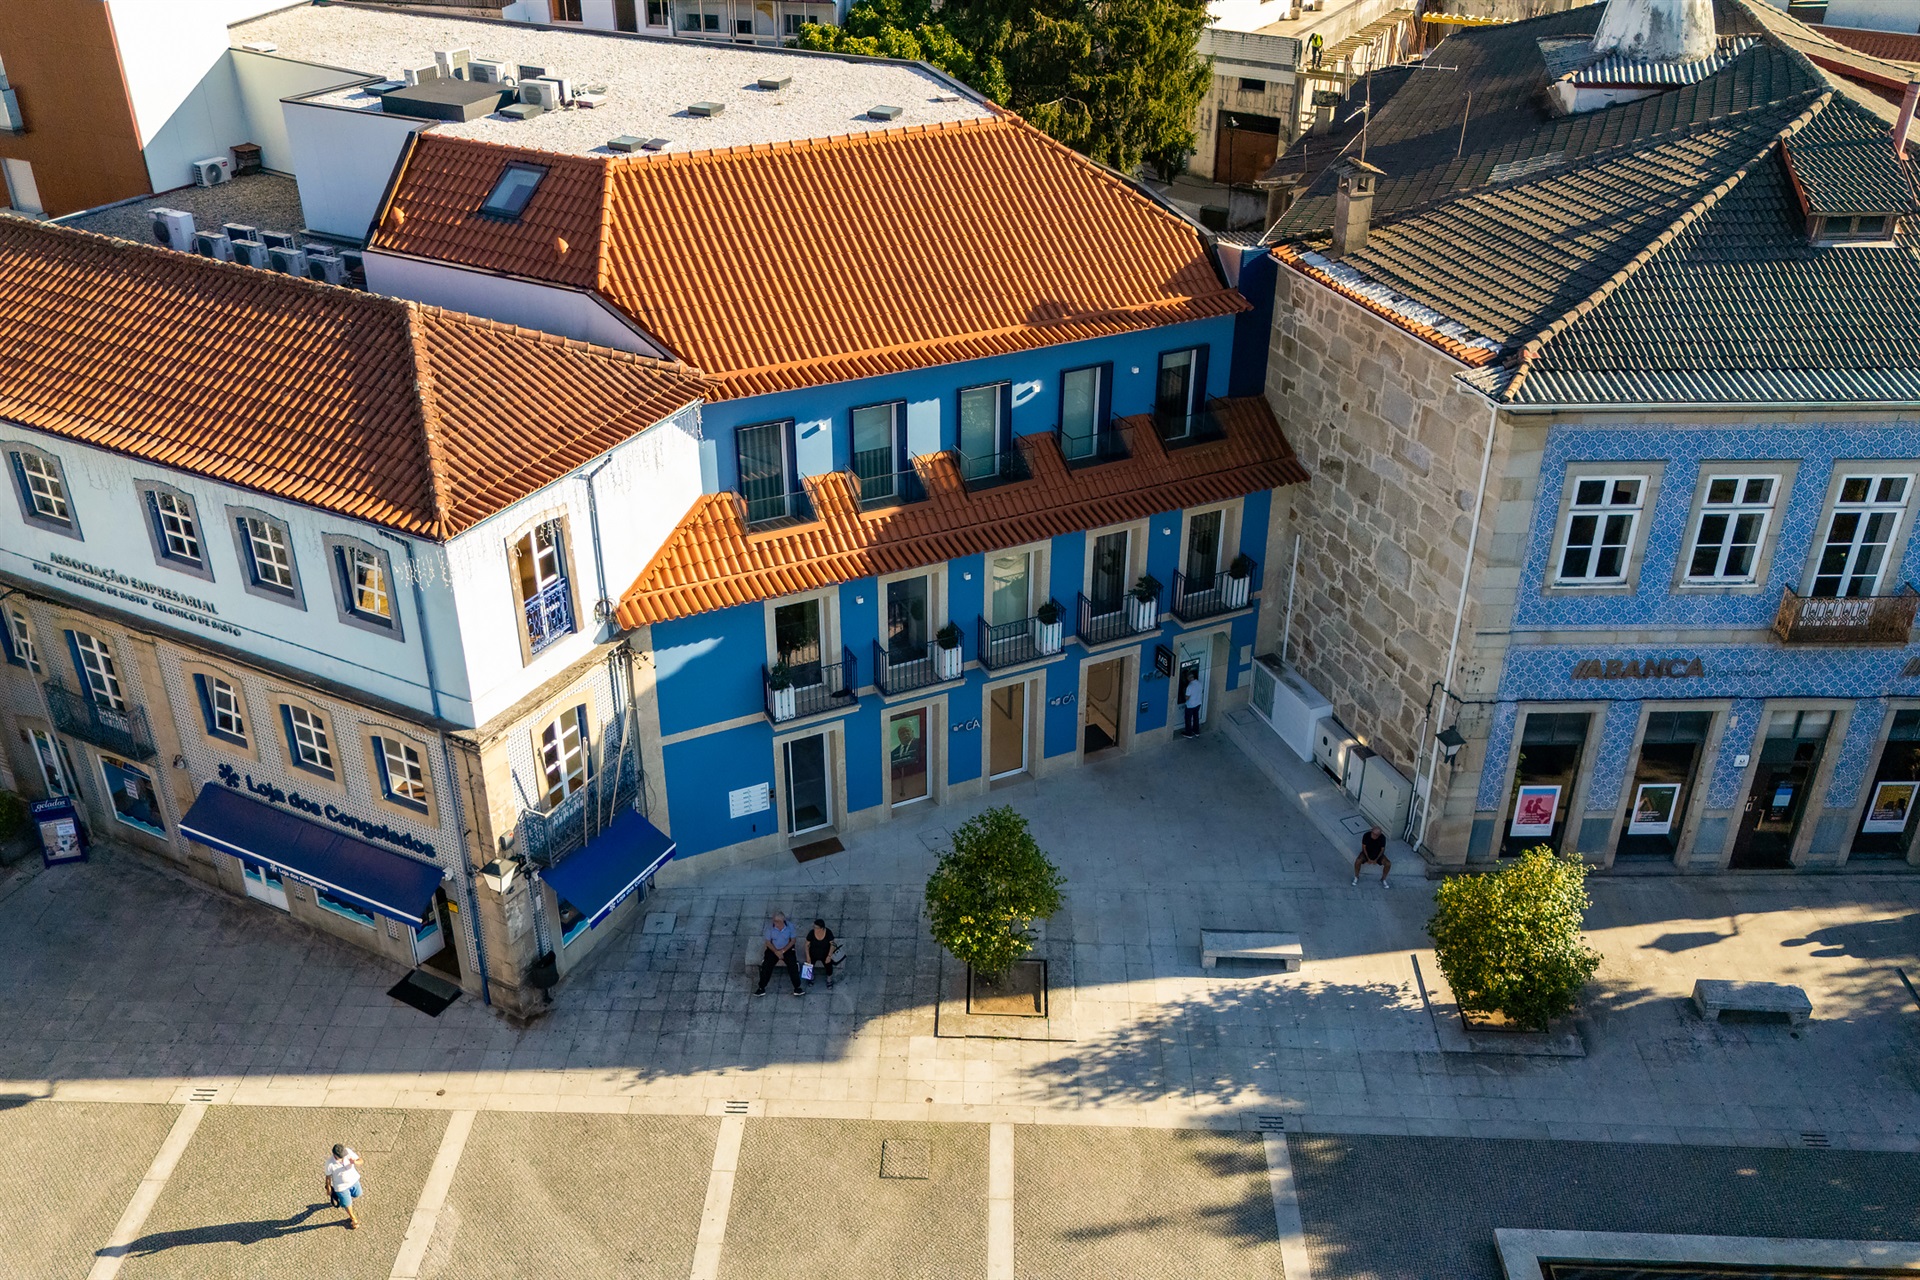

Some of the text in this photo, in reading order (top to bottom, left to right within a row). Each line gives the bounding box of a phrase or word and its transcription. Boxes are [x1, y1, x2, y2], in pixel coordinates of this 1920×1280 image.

[50, 552, 219, 615] ASSOCIAÇÃO EMPRESARIAL
[56, 570, 106, 592] CABECEIRAS
[106, 586, 119, 597] DE
[119, 590, 148, 606] BASTO
[152, 601, 197, 622] CELORICO
[198, 615, 211, 627] DE
[211, 620, 241, 637] BASTO
[245, 774, 436, 858] Loja dos Congelados
